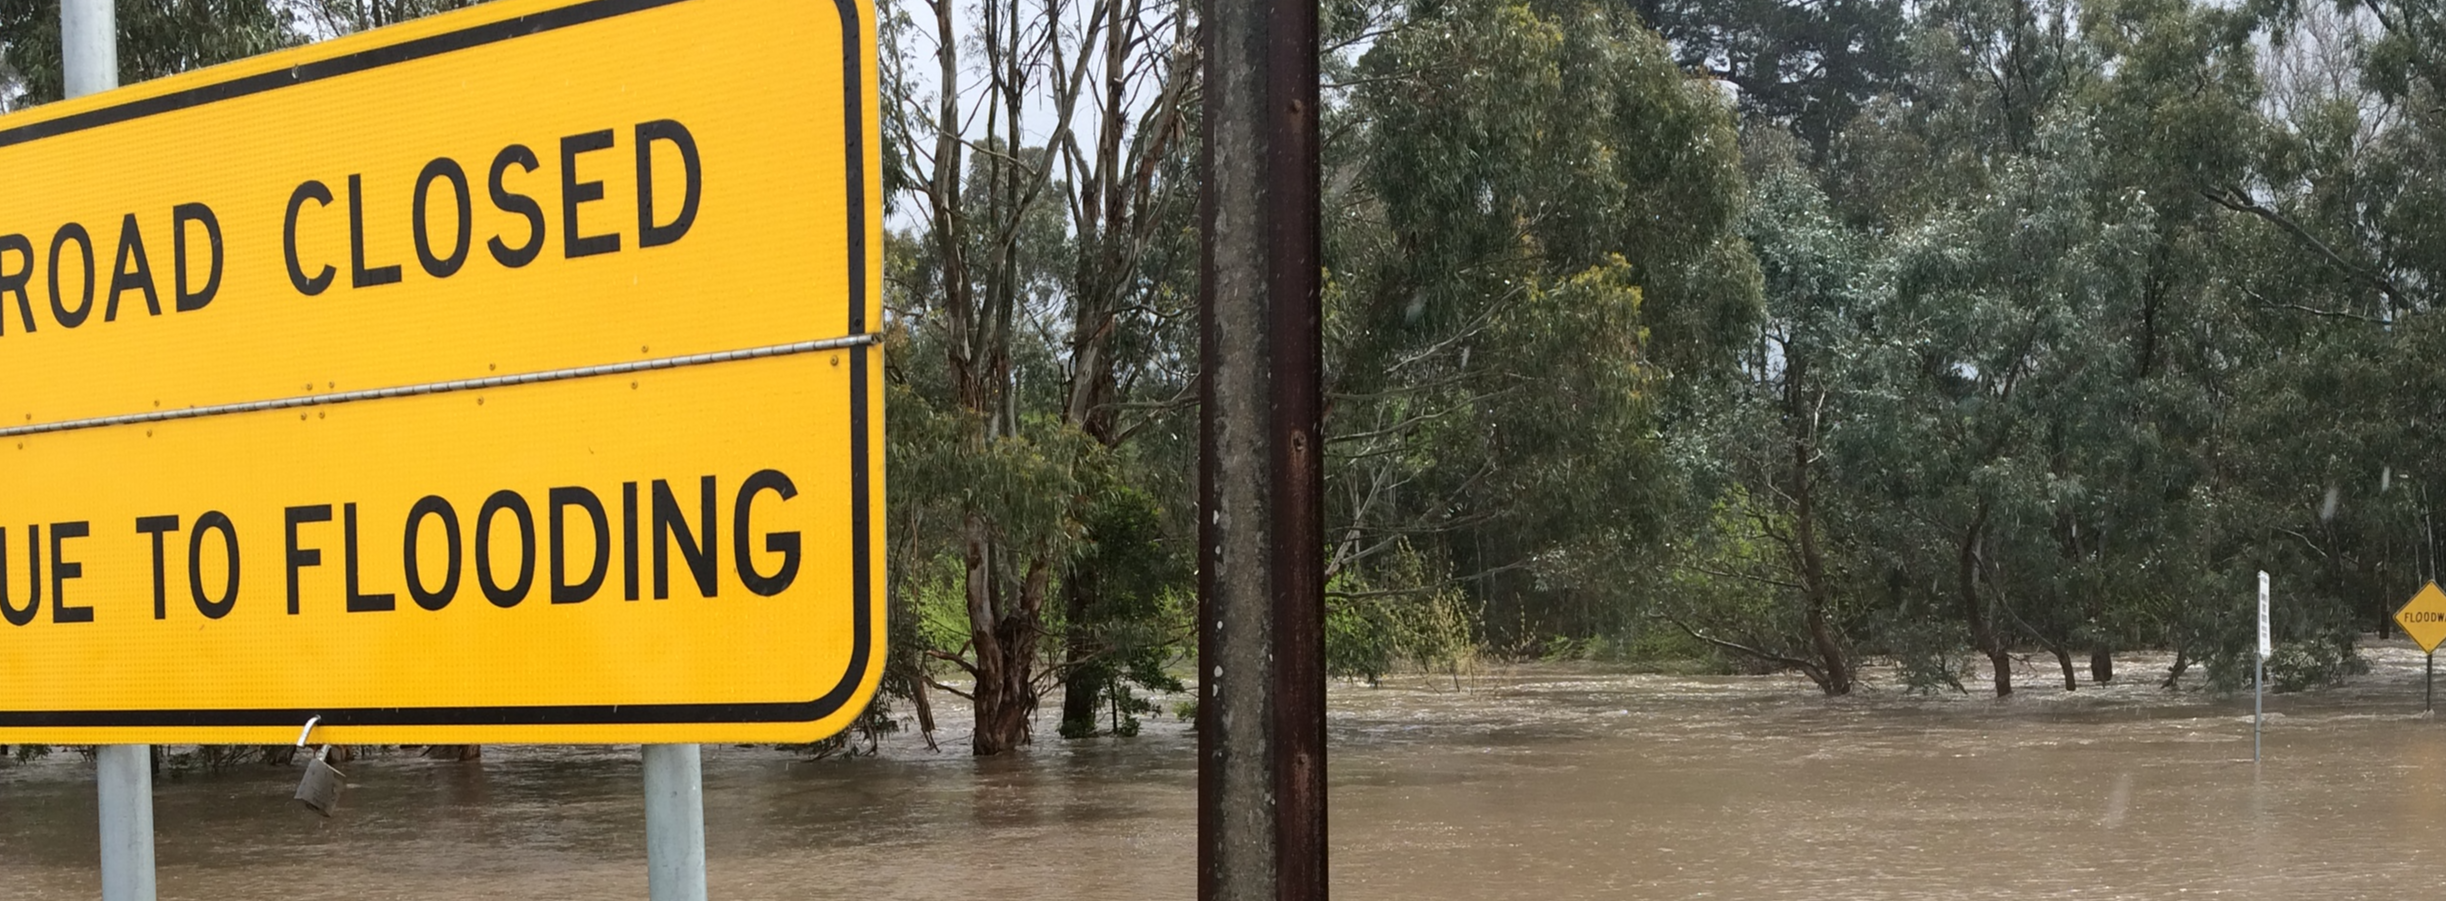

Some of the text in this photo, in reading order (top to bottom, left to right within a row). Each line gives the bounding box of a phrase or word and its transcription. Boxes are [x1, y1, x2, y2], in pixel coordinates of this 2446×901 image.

[0, 119, 702, 336] ROAD CLOSED
[135, 510, 240, 620] TO
[284, 469, 801, 615] FLOODING
[2404, 611, 2446, 623] FLOODW
